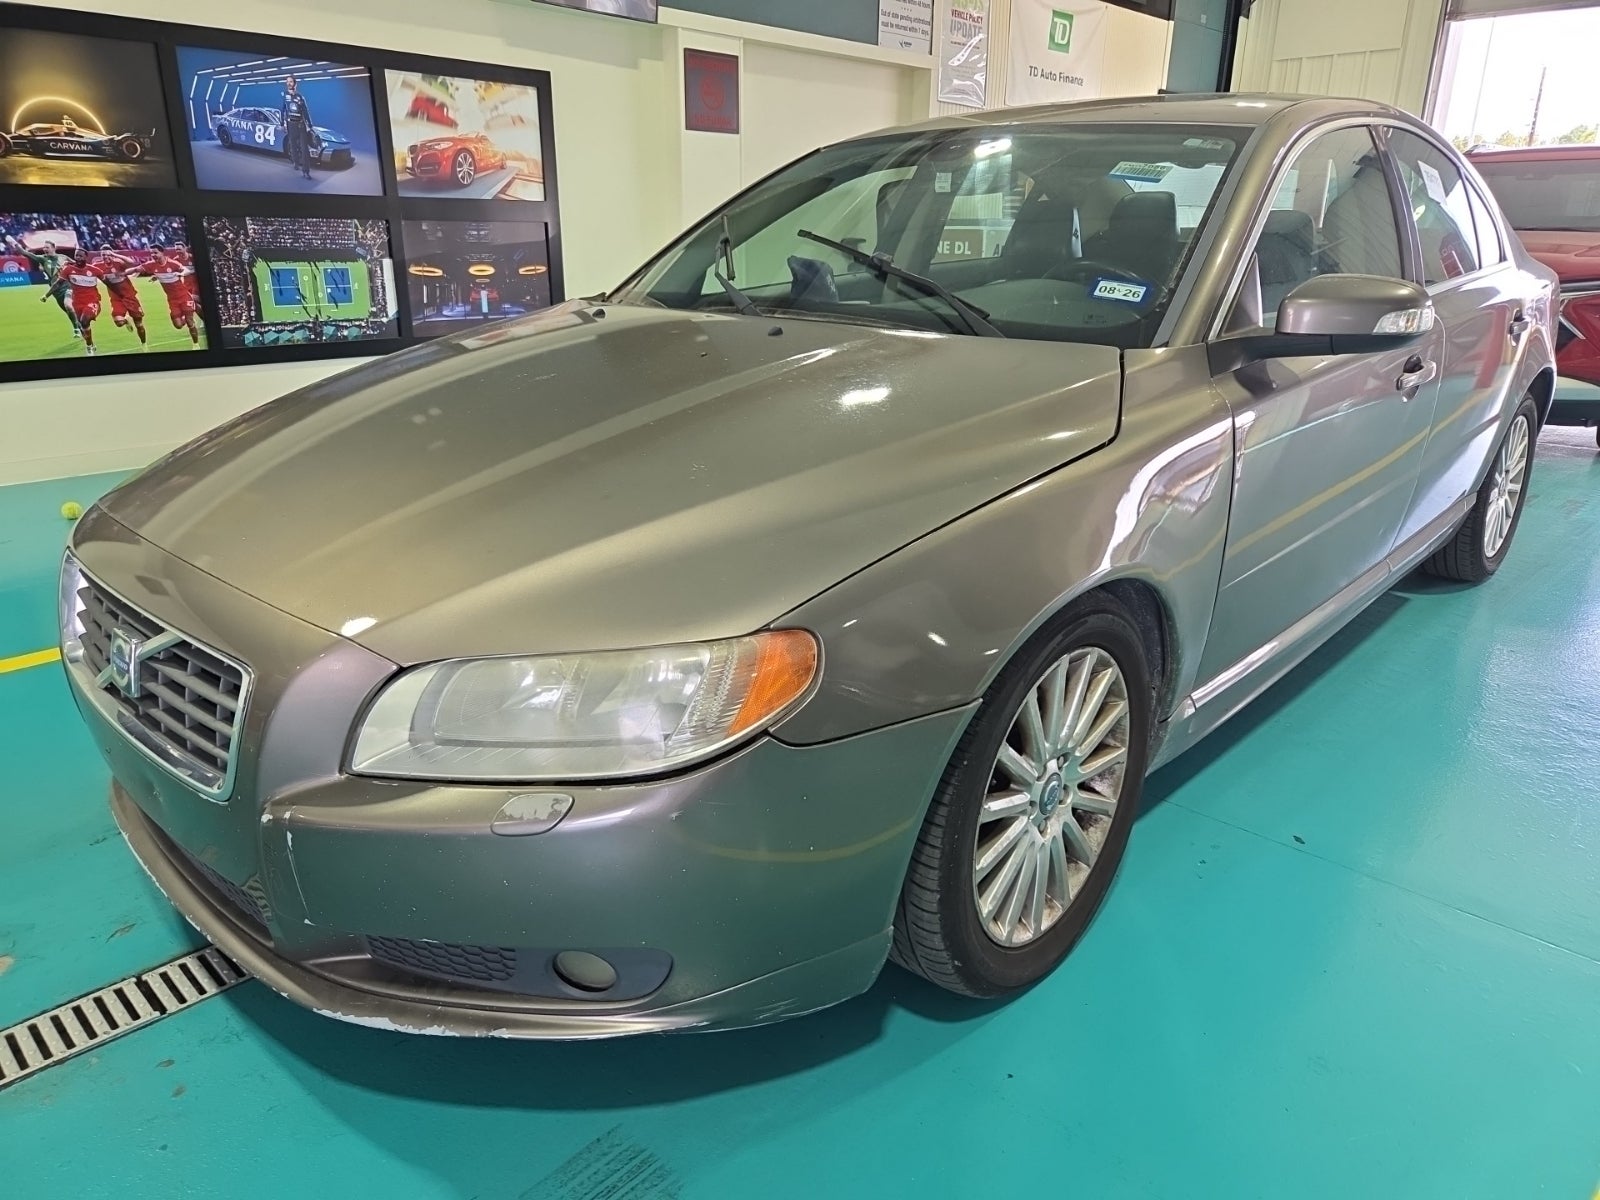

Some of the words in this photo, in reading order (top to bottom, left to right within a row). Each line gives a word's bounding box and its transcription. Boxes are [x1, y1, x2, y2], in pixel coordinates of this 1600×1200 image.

[951, 9, 968, 21] VEHICLE
[1053, 17, 1070, 45] TD
[1029, 65, 1039, 78] TD
[1040, 68, 1057, 82] Auto
[1059, 72, 1084, 87] Finance
[255, 125, 276, 146] 84
[49, 141, 93, 152] CARVANA
[954, 241, 971, 255] DL
[1098, 285, 1116, 295] 08
[1121, 288, 1142, 299] 26
